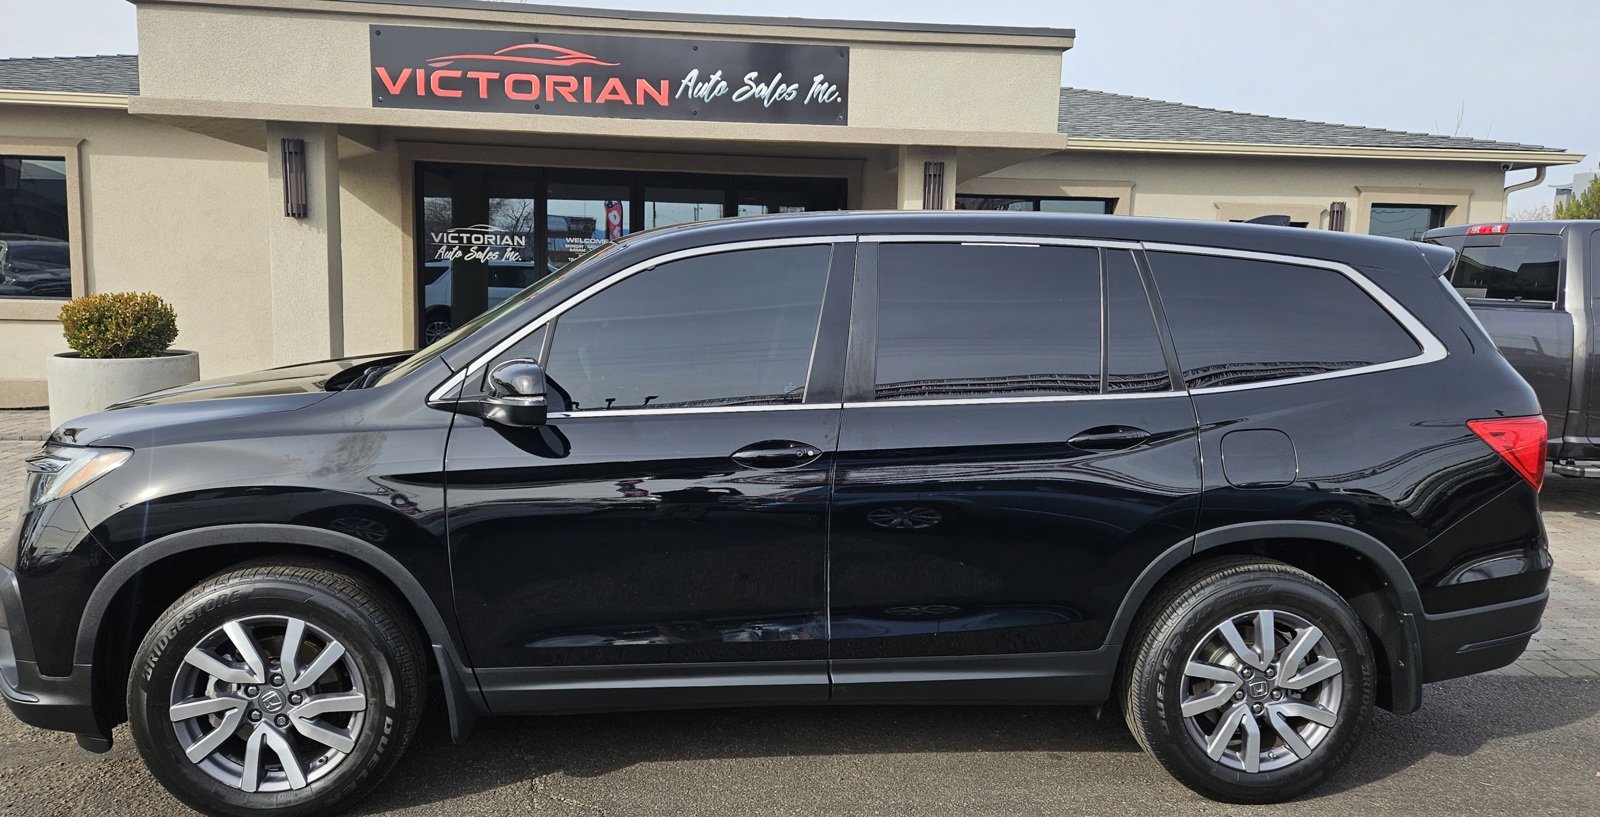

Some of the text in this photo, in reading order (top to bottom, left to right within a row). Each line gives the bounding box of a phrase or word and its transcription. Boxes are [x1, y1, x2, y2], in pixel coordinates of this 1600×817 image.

[375, 66, 842, 108] VICTORIAN Auto Sales Inc.
[431, 232, 526, 246] VICTORIAN
[434, 245, 522, 263] Auto Sales Inc.
[142, 589, 241, 681] BRIDGESTONE
